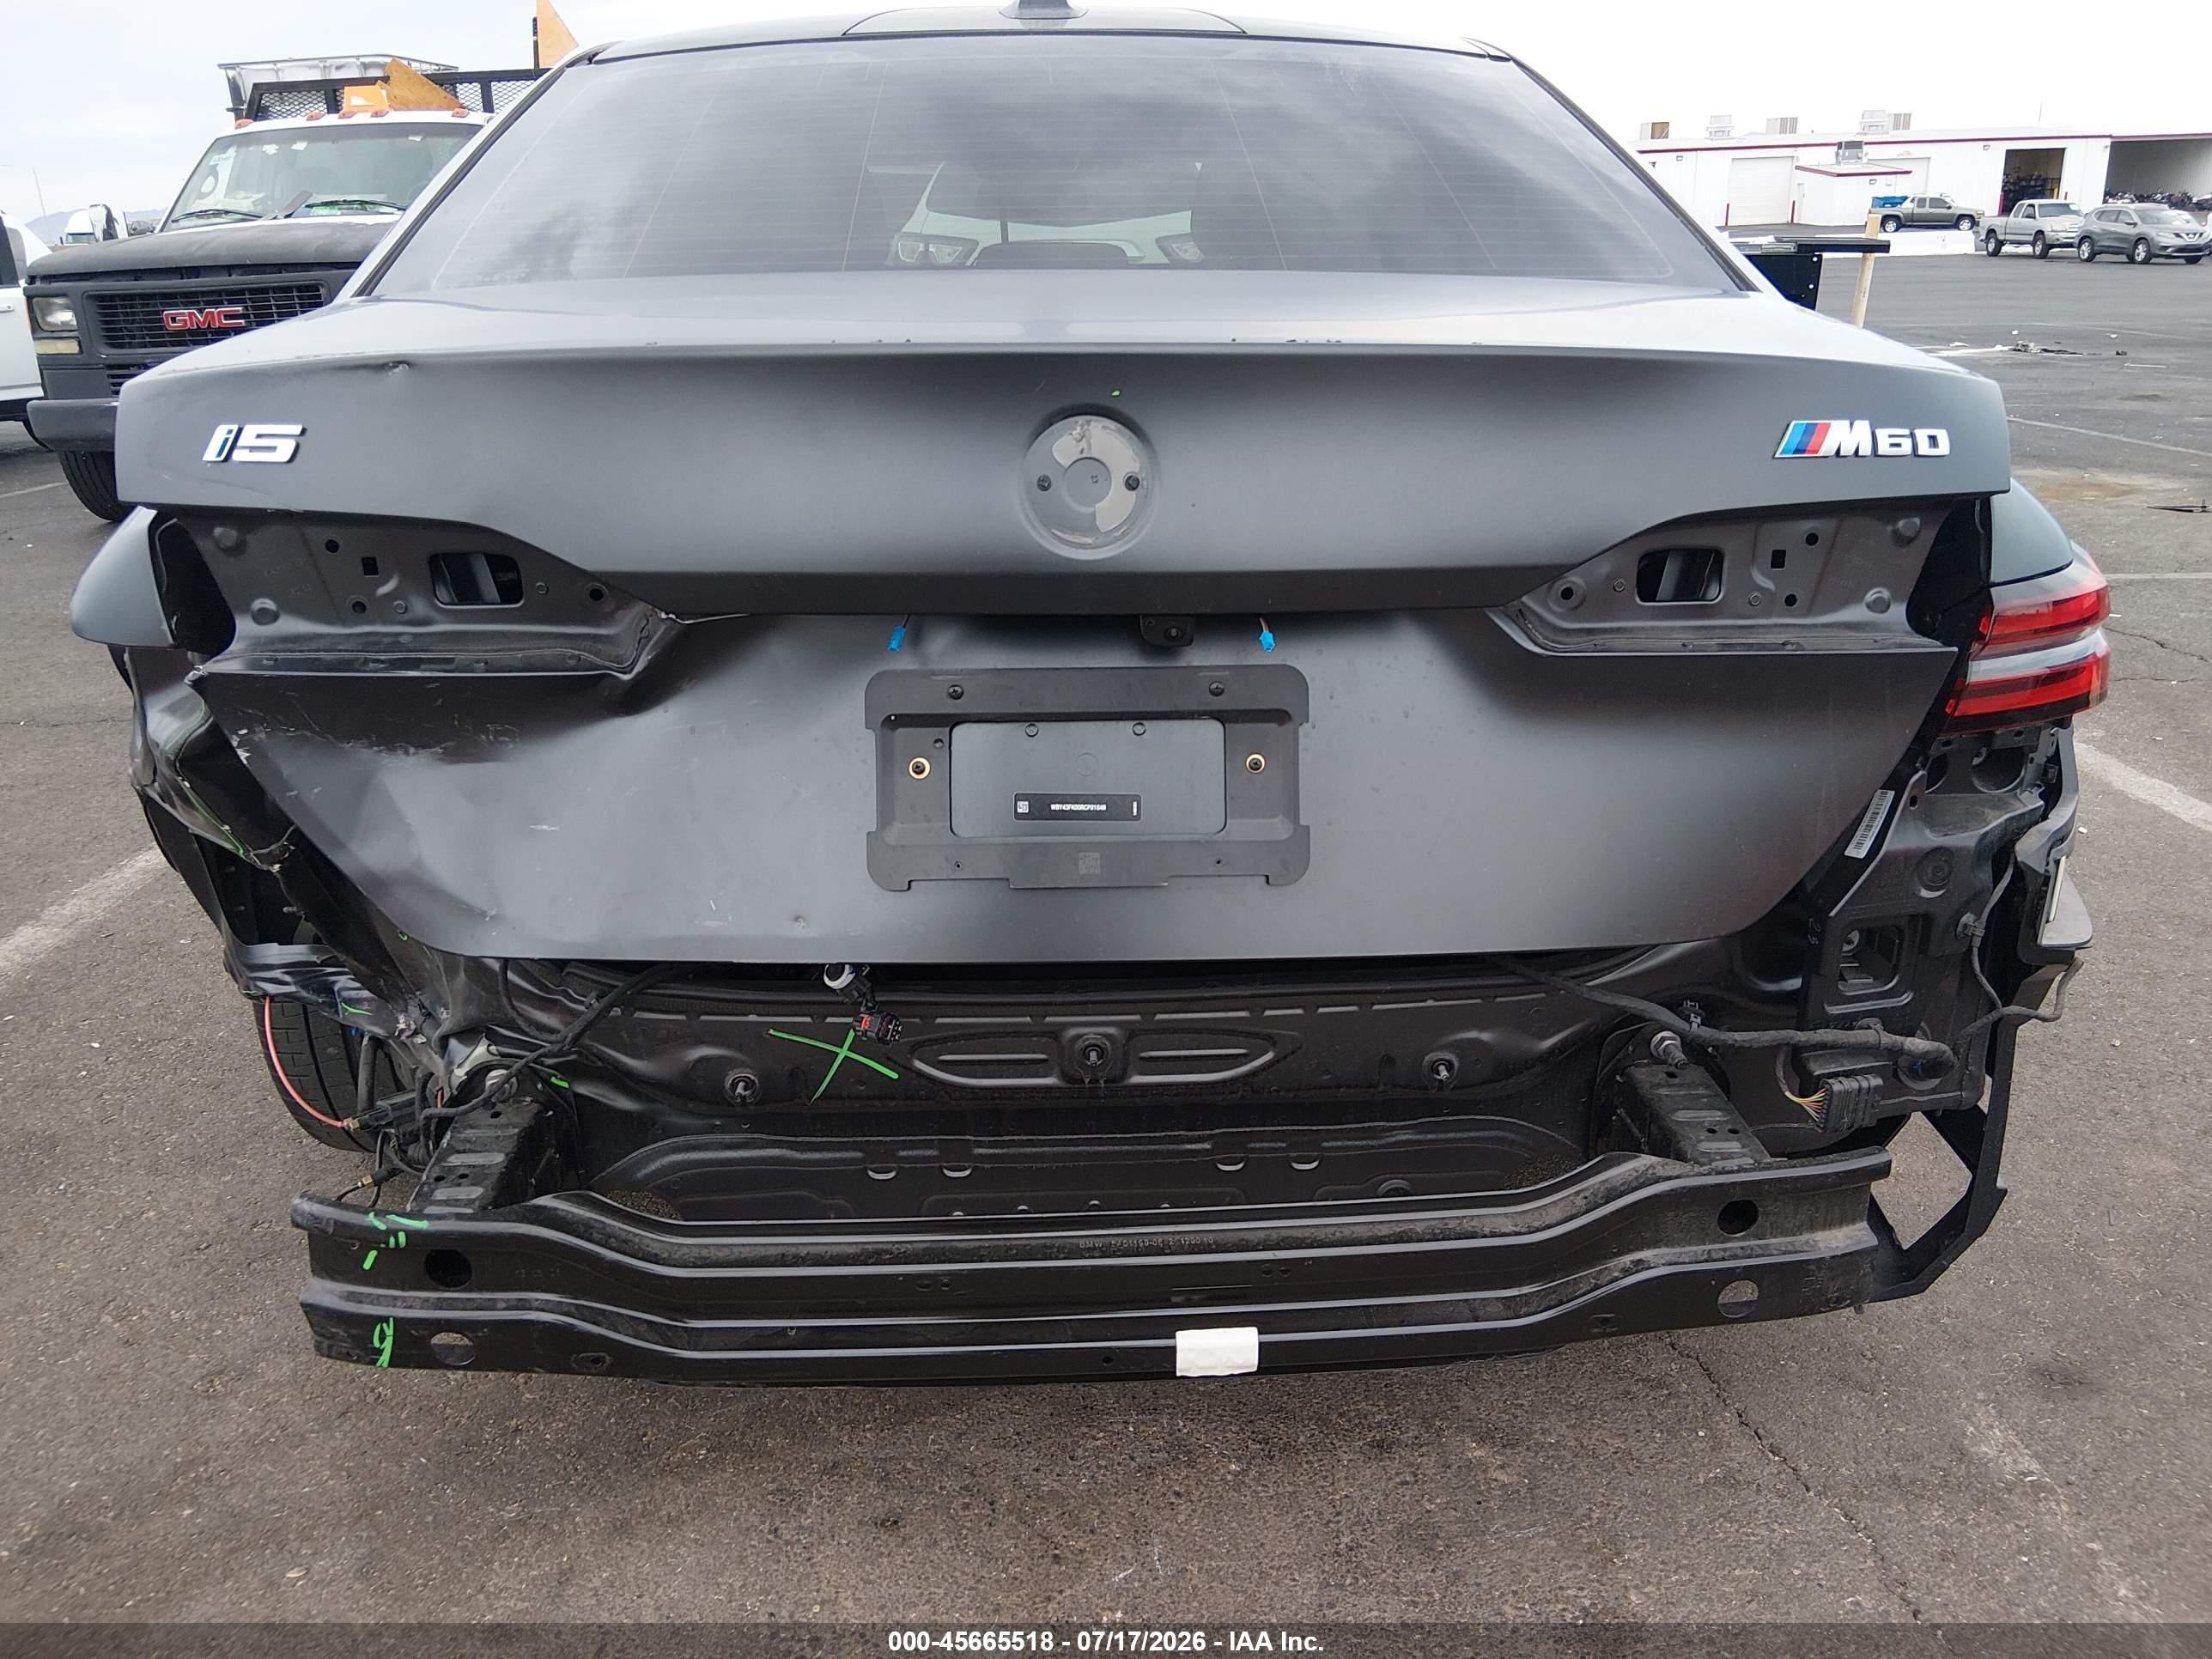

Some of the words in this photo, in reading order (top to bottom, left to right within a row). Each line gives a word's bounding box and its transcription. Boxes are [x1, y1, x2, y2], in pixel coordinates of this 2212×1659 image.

[163, 307, 247, 331] GMC
[203, 424, 304, 463] i5
[1815, 419, 1951, 457] M60
